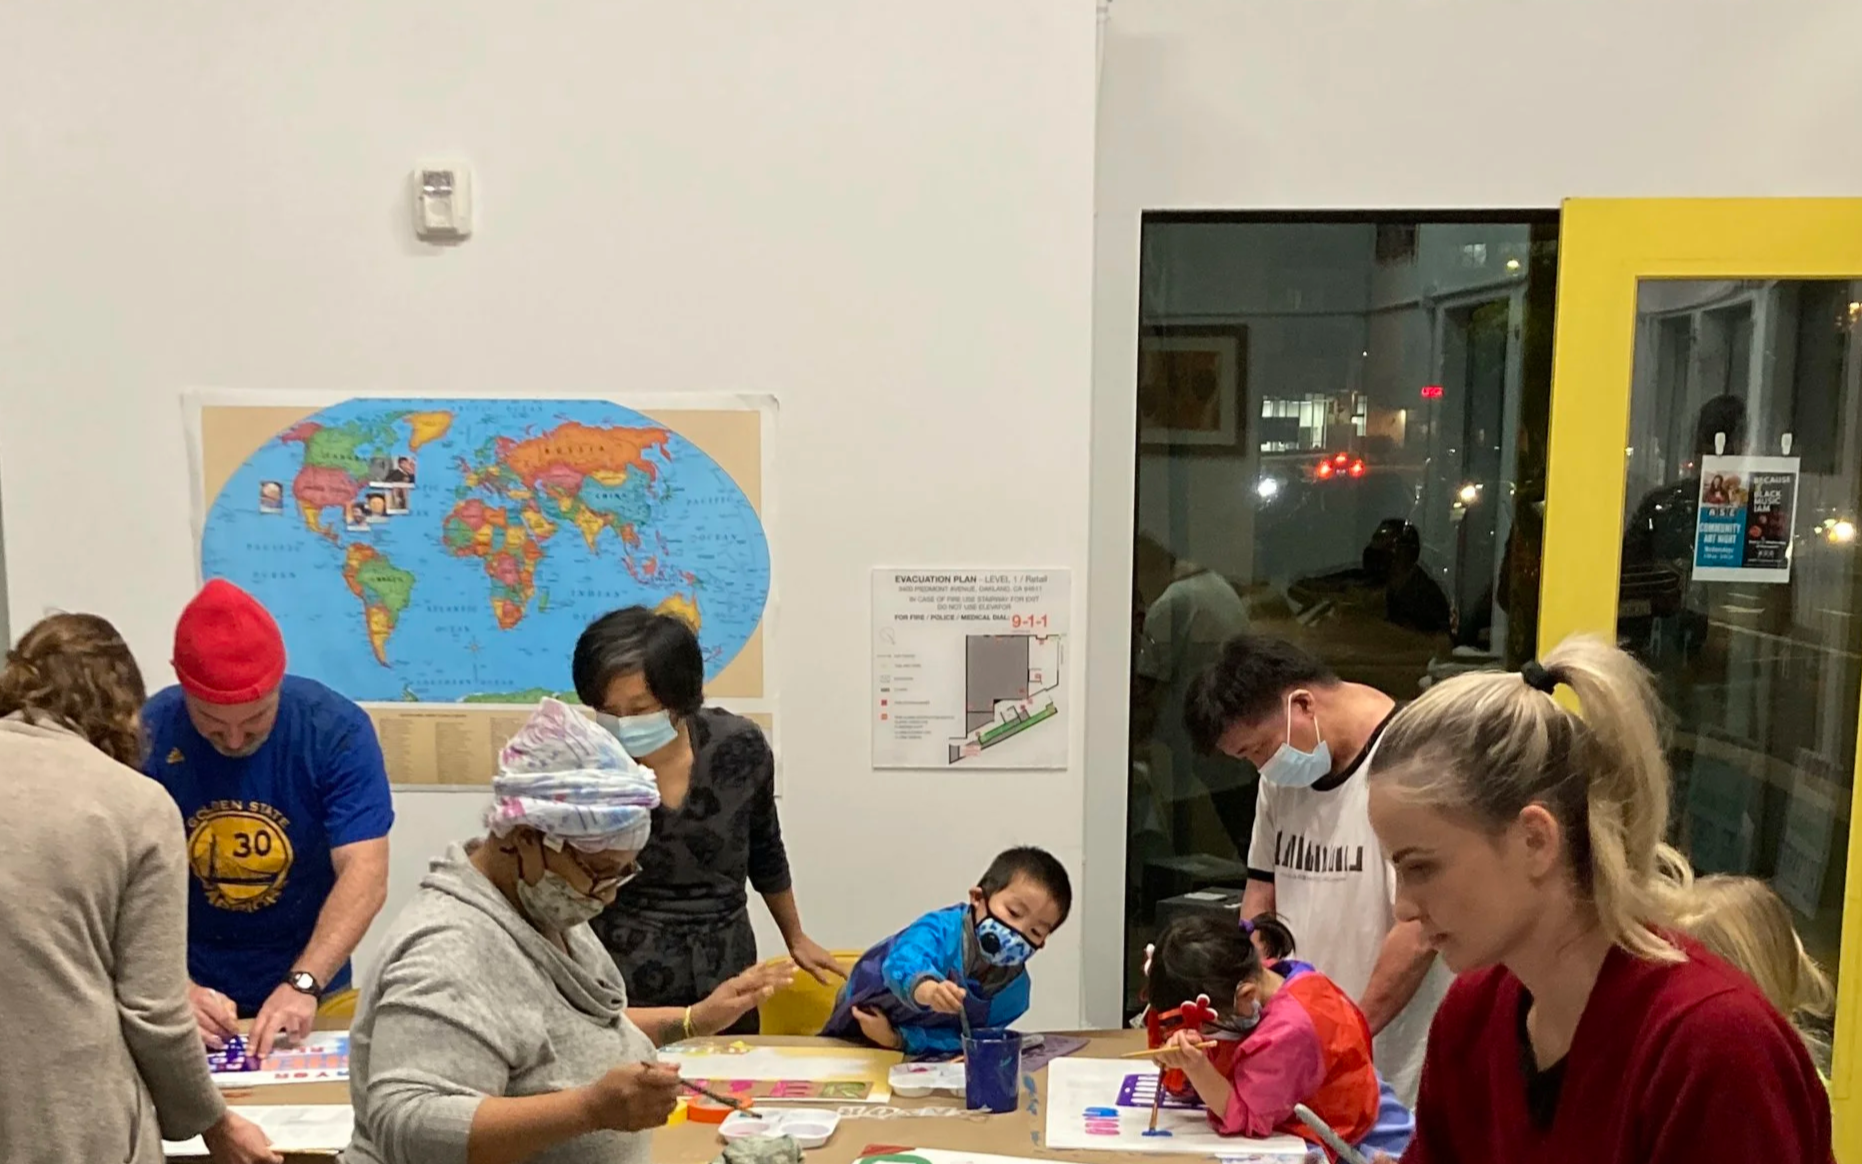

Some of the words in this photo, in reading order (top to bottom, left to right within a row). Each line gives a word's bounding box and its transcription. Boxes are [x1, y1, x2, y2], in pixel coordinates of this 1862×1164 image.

[1754, 497, 1781, 505] MUSIC
[984, 575, 1010, 583] LEVEL
[1025, 575, 1048, 583] Retail
[1012, 613, 1048, 628] 9-1-1
[248, 801, 291, 828] STATE
[232, 829, 272, 858] 30
